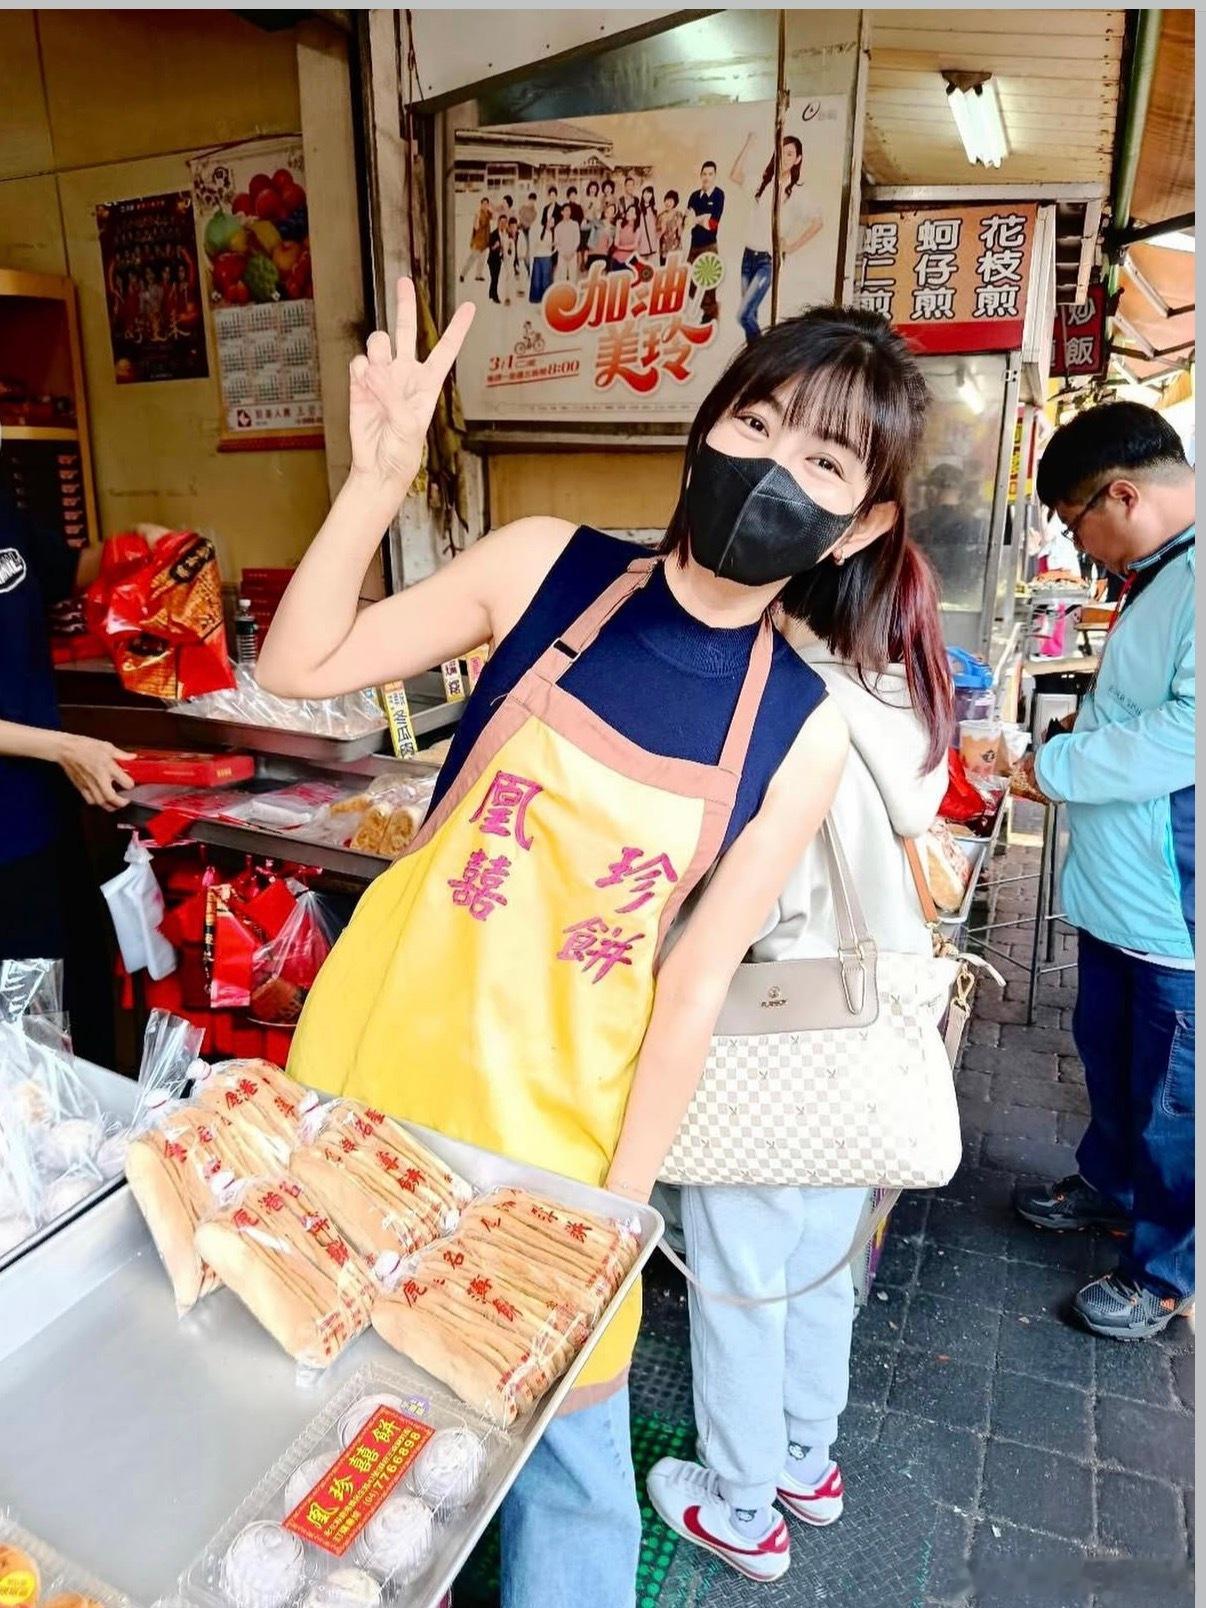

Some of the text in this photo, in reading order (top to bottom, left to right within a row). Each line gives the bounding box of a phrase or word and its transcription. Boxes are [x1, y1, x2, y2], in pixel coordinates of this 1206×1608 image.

[545, 256, 690, 333] 加油
[911, 218, 963, 320] 蚵仔煎
[973, 213, 1027, 317] 花枝煎
[594, 320, 717, 395] 美玲
